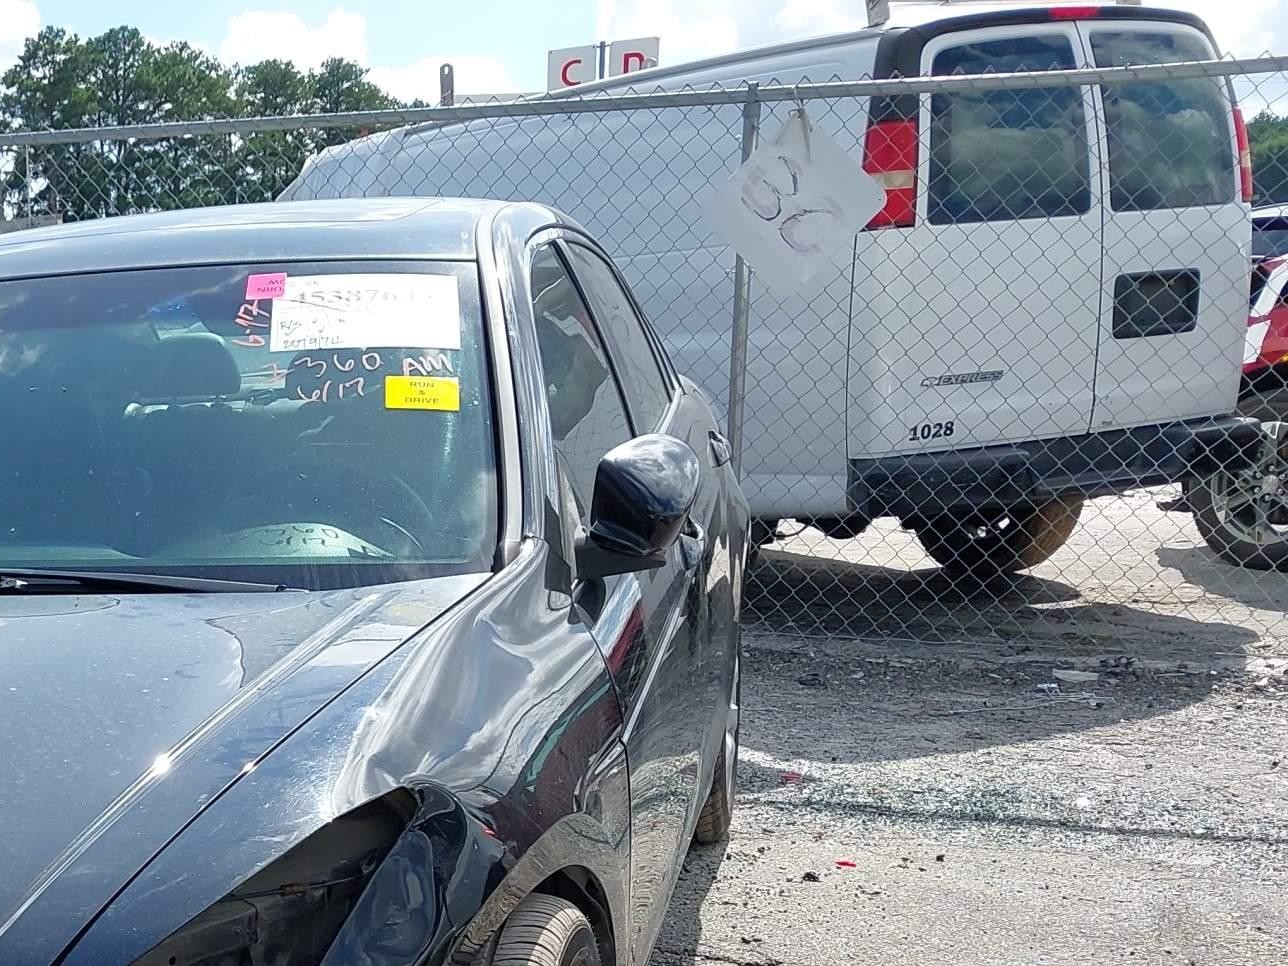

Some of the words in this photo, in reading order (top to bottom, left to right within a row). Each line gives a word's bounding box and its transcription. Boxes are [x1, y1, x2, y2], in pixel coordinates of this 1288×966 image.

[561, 58, 582, 87] C
[403, 353, 454, 376] AM
[938, 370, 1004, 386] EXPRESS
[404, 396, 440, 404] DRIVE
[909, 421, 955, 441] 1028
